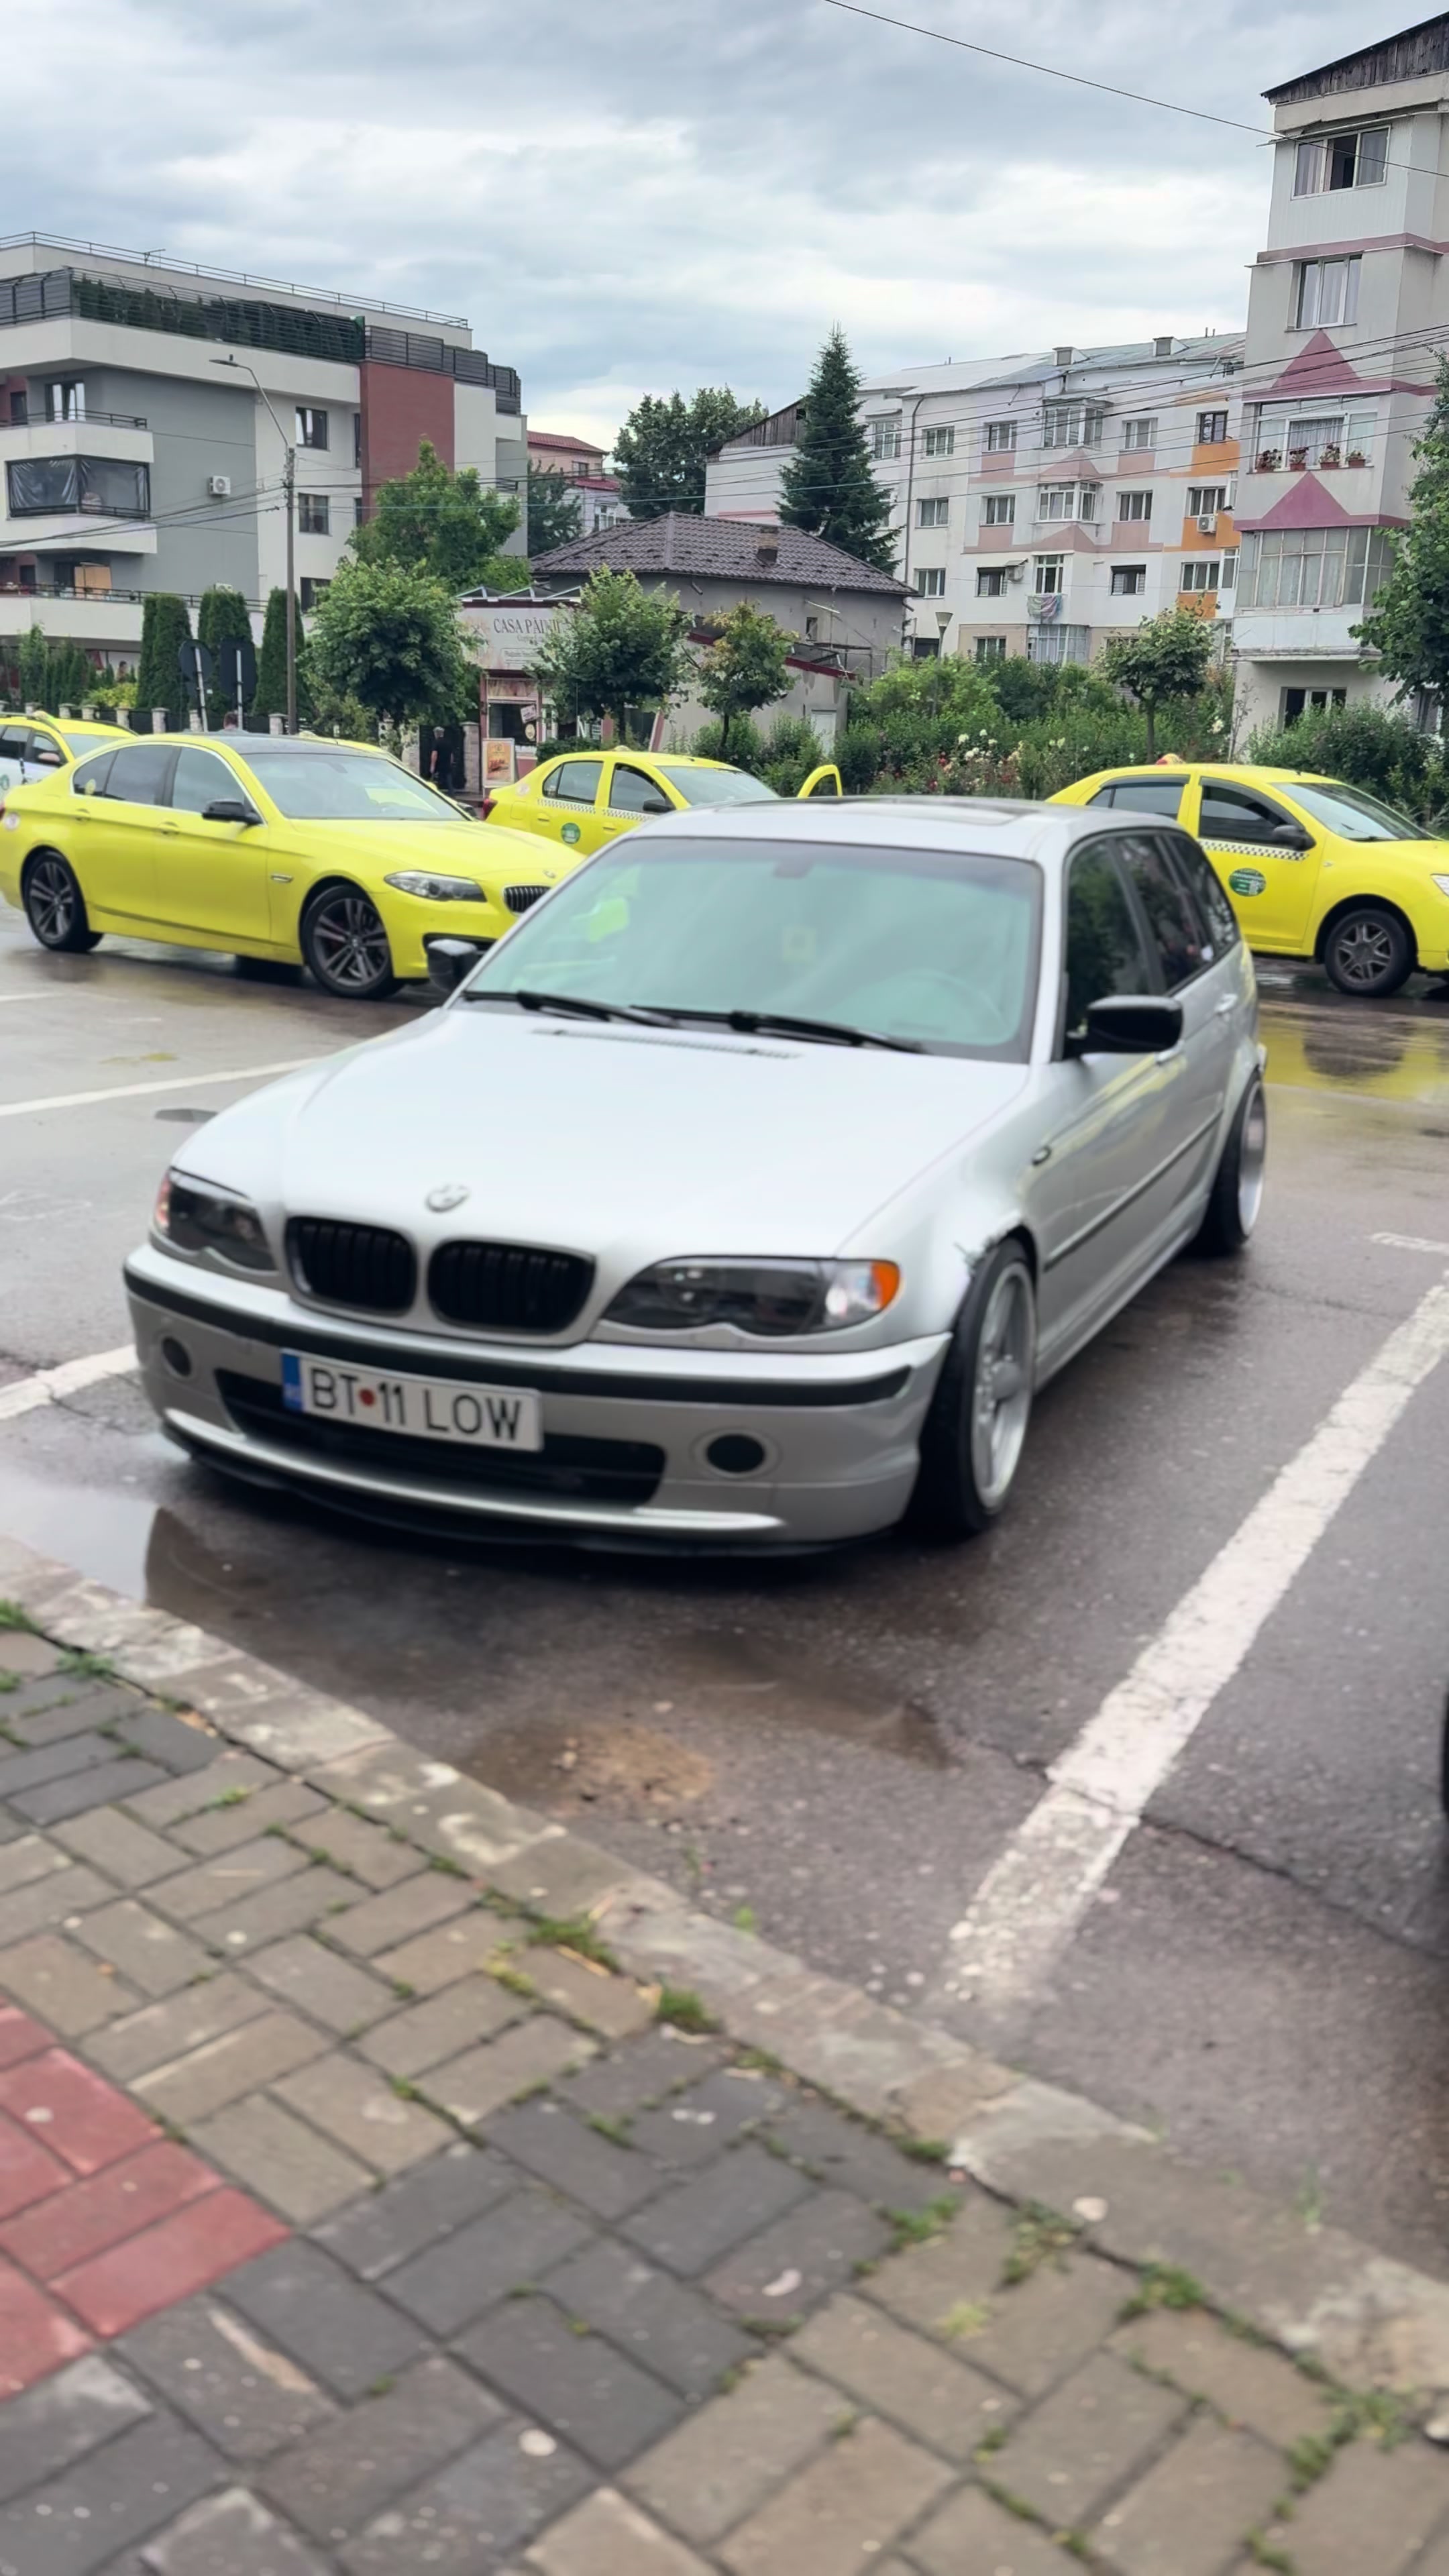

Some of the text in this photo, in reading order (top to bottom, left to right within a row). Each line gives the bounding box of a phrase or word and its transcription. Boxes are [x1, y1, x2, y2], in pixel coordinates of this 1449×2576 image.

[493, 618, 524, 634] CASA
[310, 1367, 522, 1442] BT 11 LOW
